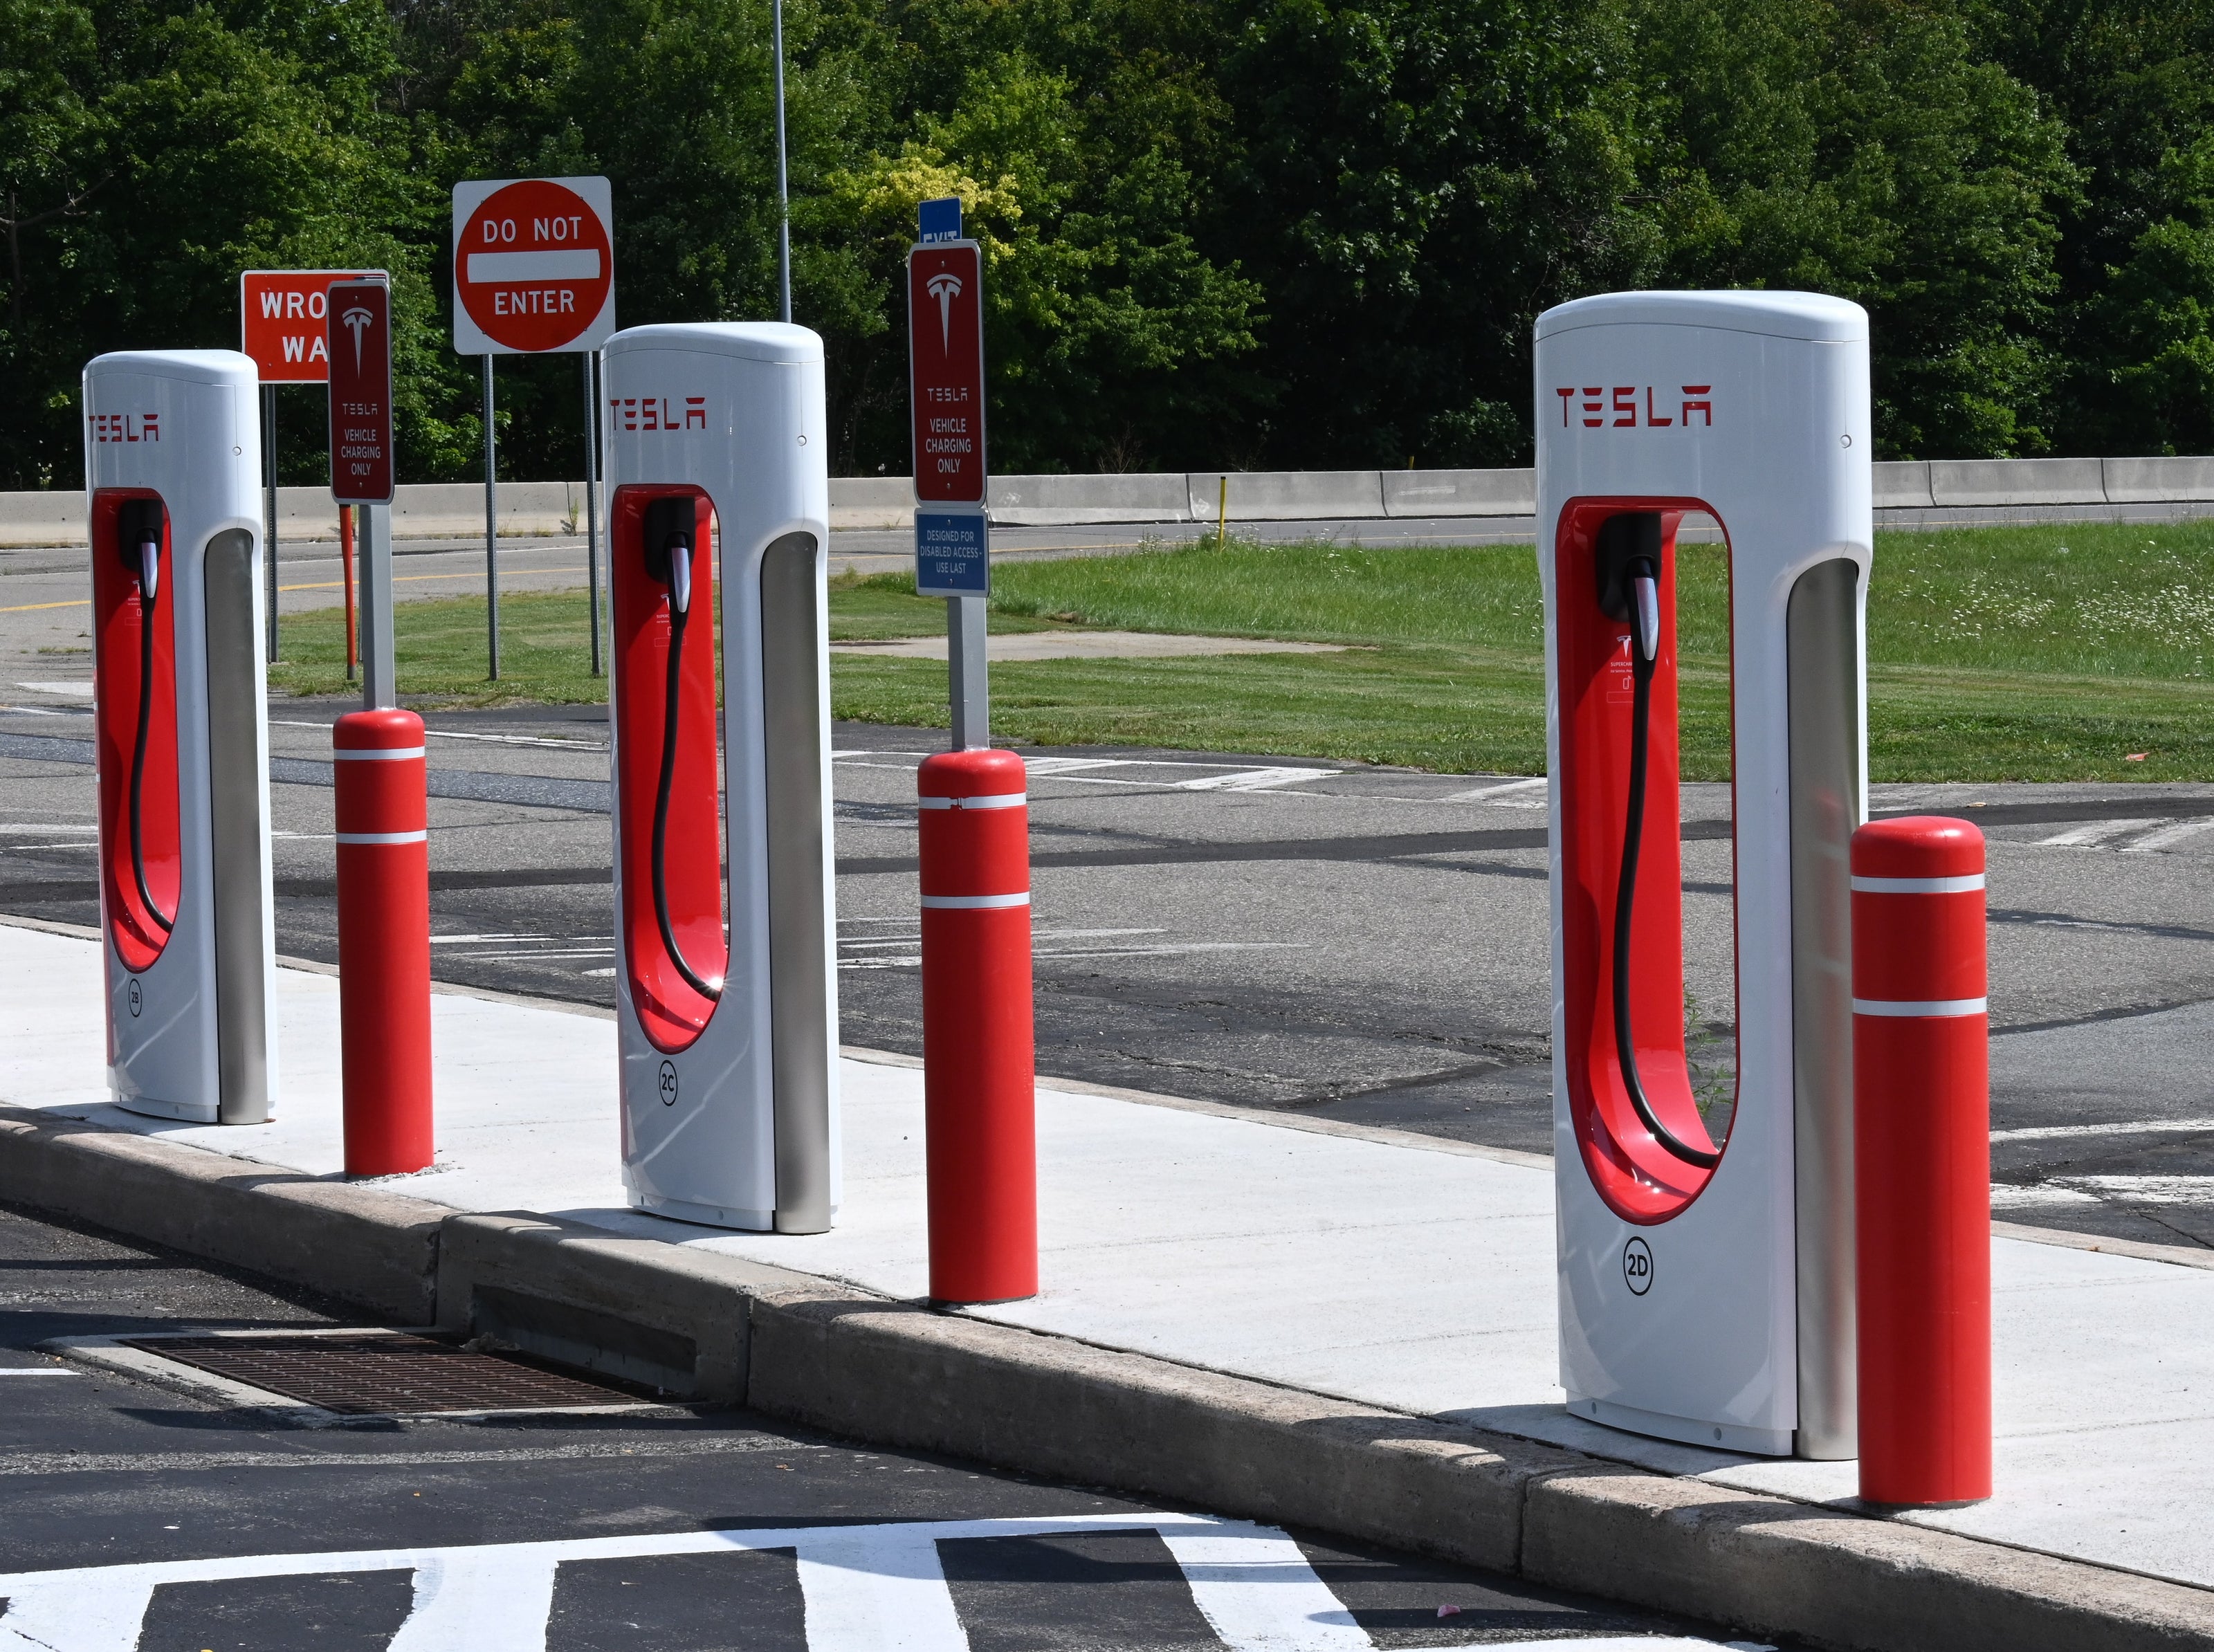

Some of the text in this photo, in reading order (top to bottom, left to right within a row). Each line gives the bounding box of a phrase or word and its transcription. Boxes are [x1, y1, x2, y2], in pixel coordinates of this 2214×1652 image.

[484, 216, 582, 243] DO NOT
[260, 291, 327, 319] WRO
[495, 289, 575, 315] ENTER
[282, 336, 329, 362] WA
[927, 387, 968, 402] TESLA
[342, 403, 378, 415] TESLA
[610, 397, 706, 430] TESLA
[1556, 385, 1712, 428] TESLA
[88, 414, 159, 442] TESLA
[929, 418, 967, 433] VEHICLE
[344, 428, 376, 442] VEHICLE
[340, 446, 381, 459] CHARGING
[925, 438, 971, 453] CHARGING
[351, 462, 372, 476] ONLY
[937, 458, 961, 473] ONLY
[926, 530, 974, 542] DESIGNED FOR
[920, 545, 952, 558] DISABLED
[935, 562, 967, 575] USE LAST
[131, 991, 139, 1004] 2B
[661, 1073, 675, 1092] 2C
[1627, 1254, 1648, 1277] 2D
